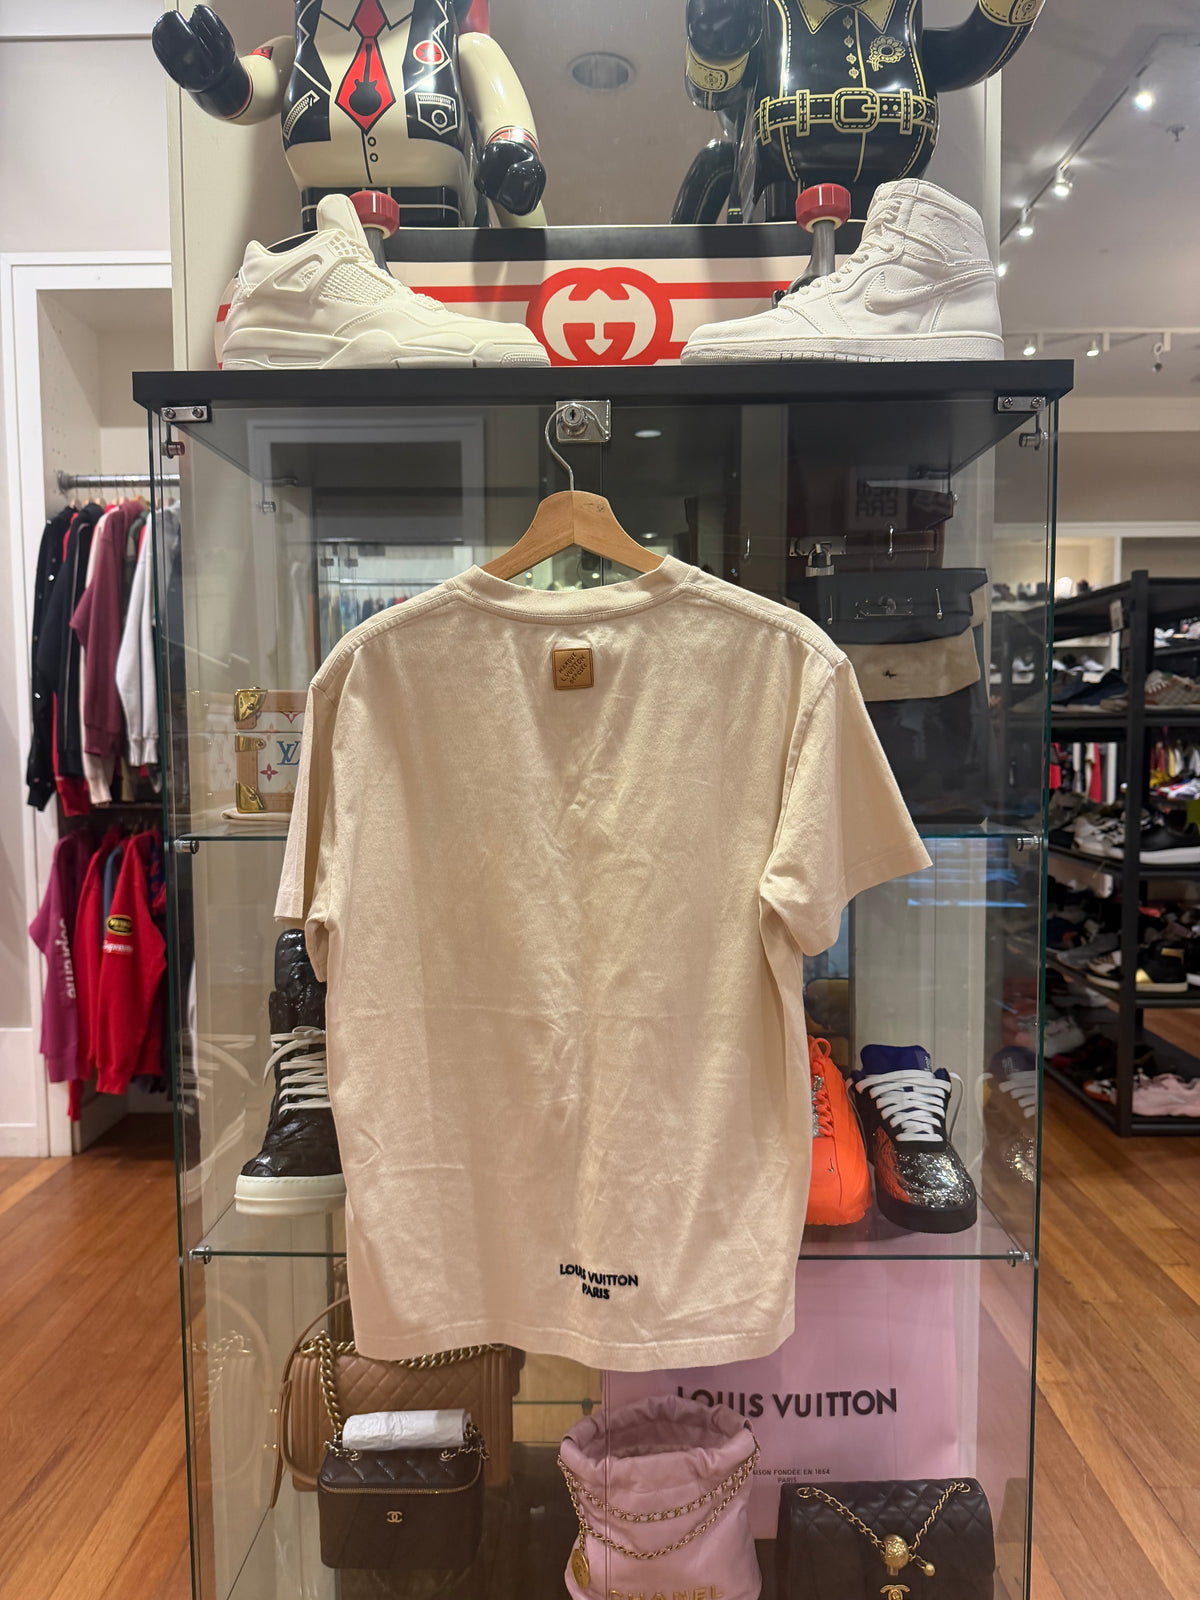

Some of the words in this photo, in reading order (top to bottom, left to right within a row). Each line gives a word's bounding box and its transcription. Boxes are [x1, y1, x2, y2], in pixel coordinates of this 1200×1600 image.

[559, 1263, 587, 1281] LOUIS
[587, 1271, 639, 1287] VUITTON
[582, 1282, 610, 1300] PARIS
[771, 1387, 897, 1419] VUITTON
